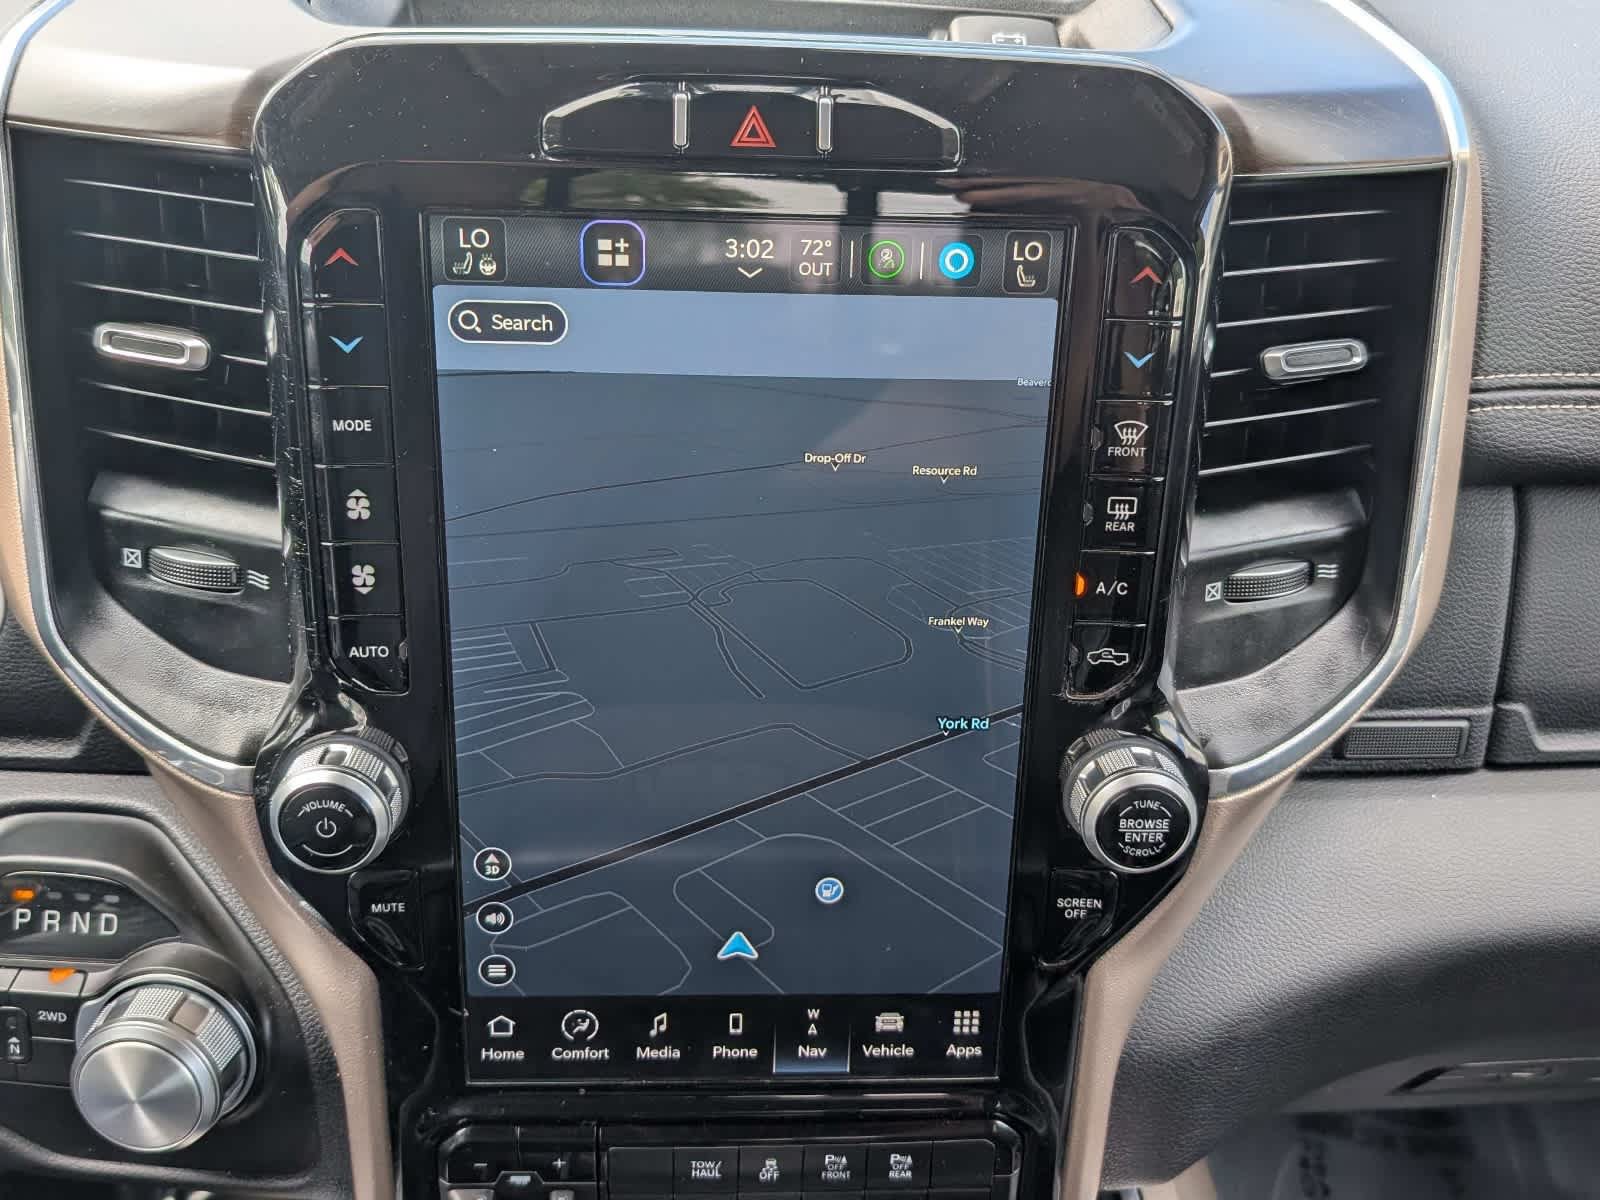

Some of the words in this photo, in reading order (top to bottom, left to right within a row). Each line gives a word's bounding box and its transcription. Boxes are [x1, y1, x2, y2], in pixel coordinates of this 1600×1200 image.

[459, 228, 490, 249] LO
[725, 238, 774, 259] 3:02
[800, 239, 832, 256] 72°
[1013, 241, 1043, 262] LO
[799, 262, 833, 277] OUT
[491, 314, 553, 332] Search
[332, 419, 373, 432] MODE
[1107, 446, 1147, 457] FRONT
[804, 453, 851, 464] Drop-Off
[853, 453, 867, 463] Dr
[912, 465, 961, 475] Resource
[962, 466, 977, 475] Rd
[1105, 521, 1136, 532] REAR
[1095, 580, 1129, 596] A/C
[928, 616, 965, 626] Frankel
[967, 617, 989, 628] Way
[349, 646, 389, 658] AUTO
[938, 717, 968, 729] York
[971, 717, 990, 729] Rd
[302, 799, 346, 812] VOLUME
[1133, 800, 1161, 810] TUNE
[1119, 818, 1170, 829] BROWSE
[1124, 832, 1163, 843] ENTER
[1122, 845, 1161, 857] SCROLL
[485, 865, 500, 875] 3D
[371, 902, 406, 913] MUTE
[1056, 897, 1102, 909] SCREEN
[1064, 908, 1088, 919] OFF
[14, 908, 31, 930] P
[43, 909, 61, 932] R
[72, 911, 91, 934] N
[101, 913, 118, 935] D
[38, 1010, 68, 1023] 2WD
[481, 1047, 525, 1060] Home
[551, 1046, 610, 1060] Comfort
[636, 1046, 681, 1059] Media
[712, 1045, 758, 1058] Phone
[798, 1044, 827, 1057] Nav
[862, 1043, 915, 1057] Vehicle
[946, 1043, 982, 1059] Apps
[690, 1160, 722, 1170] TOW/
[692, 1168, 721, 1178] HAUL
[759, 1170, 780, 1180] OFF
[822, 1170, 851, 1179] FRONT
[889, 1170, 912, 1178] REAR
